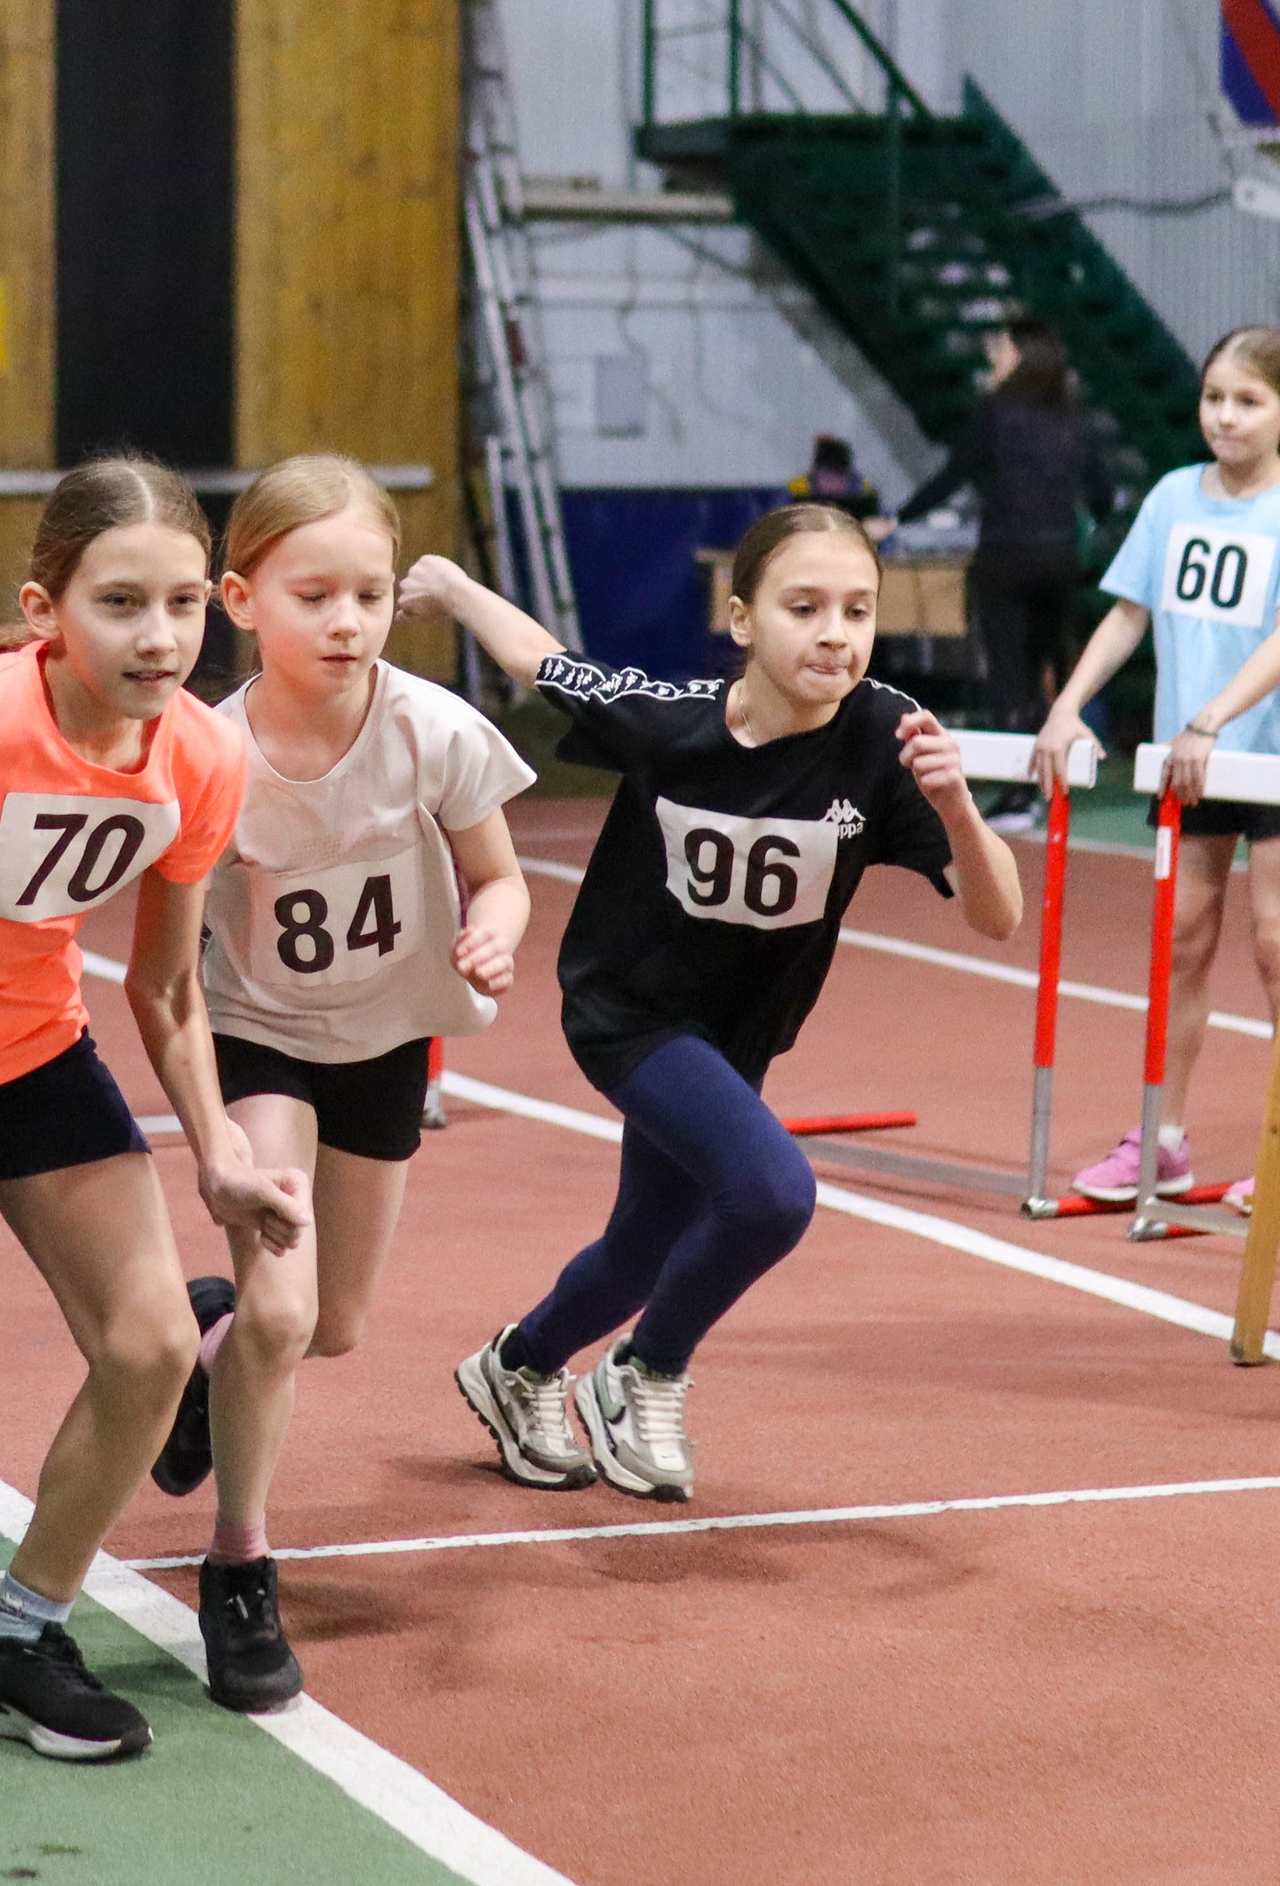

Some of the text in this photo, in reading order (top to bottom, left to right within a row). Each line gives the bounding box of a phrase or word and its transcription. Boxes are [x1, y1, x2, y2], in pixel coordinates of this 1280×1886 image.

[1176, 538, 1248, 609] 60
[15, 813, 145, 905] 70
[683, 829, 801, 917] 96
[274, 874, 402, 974] 84
